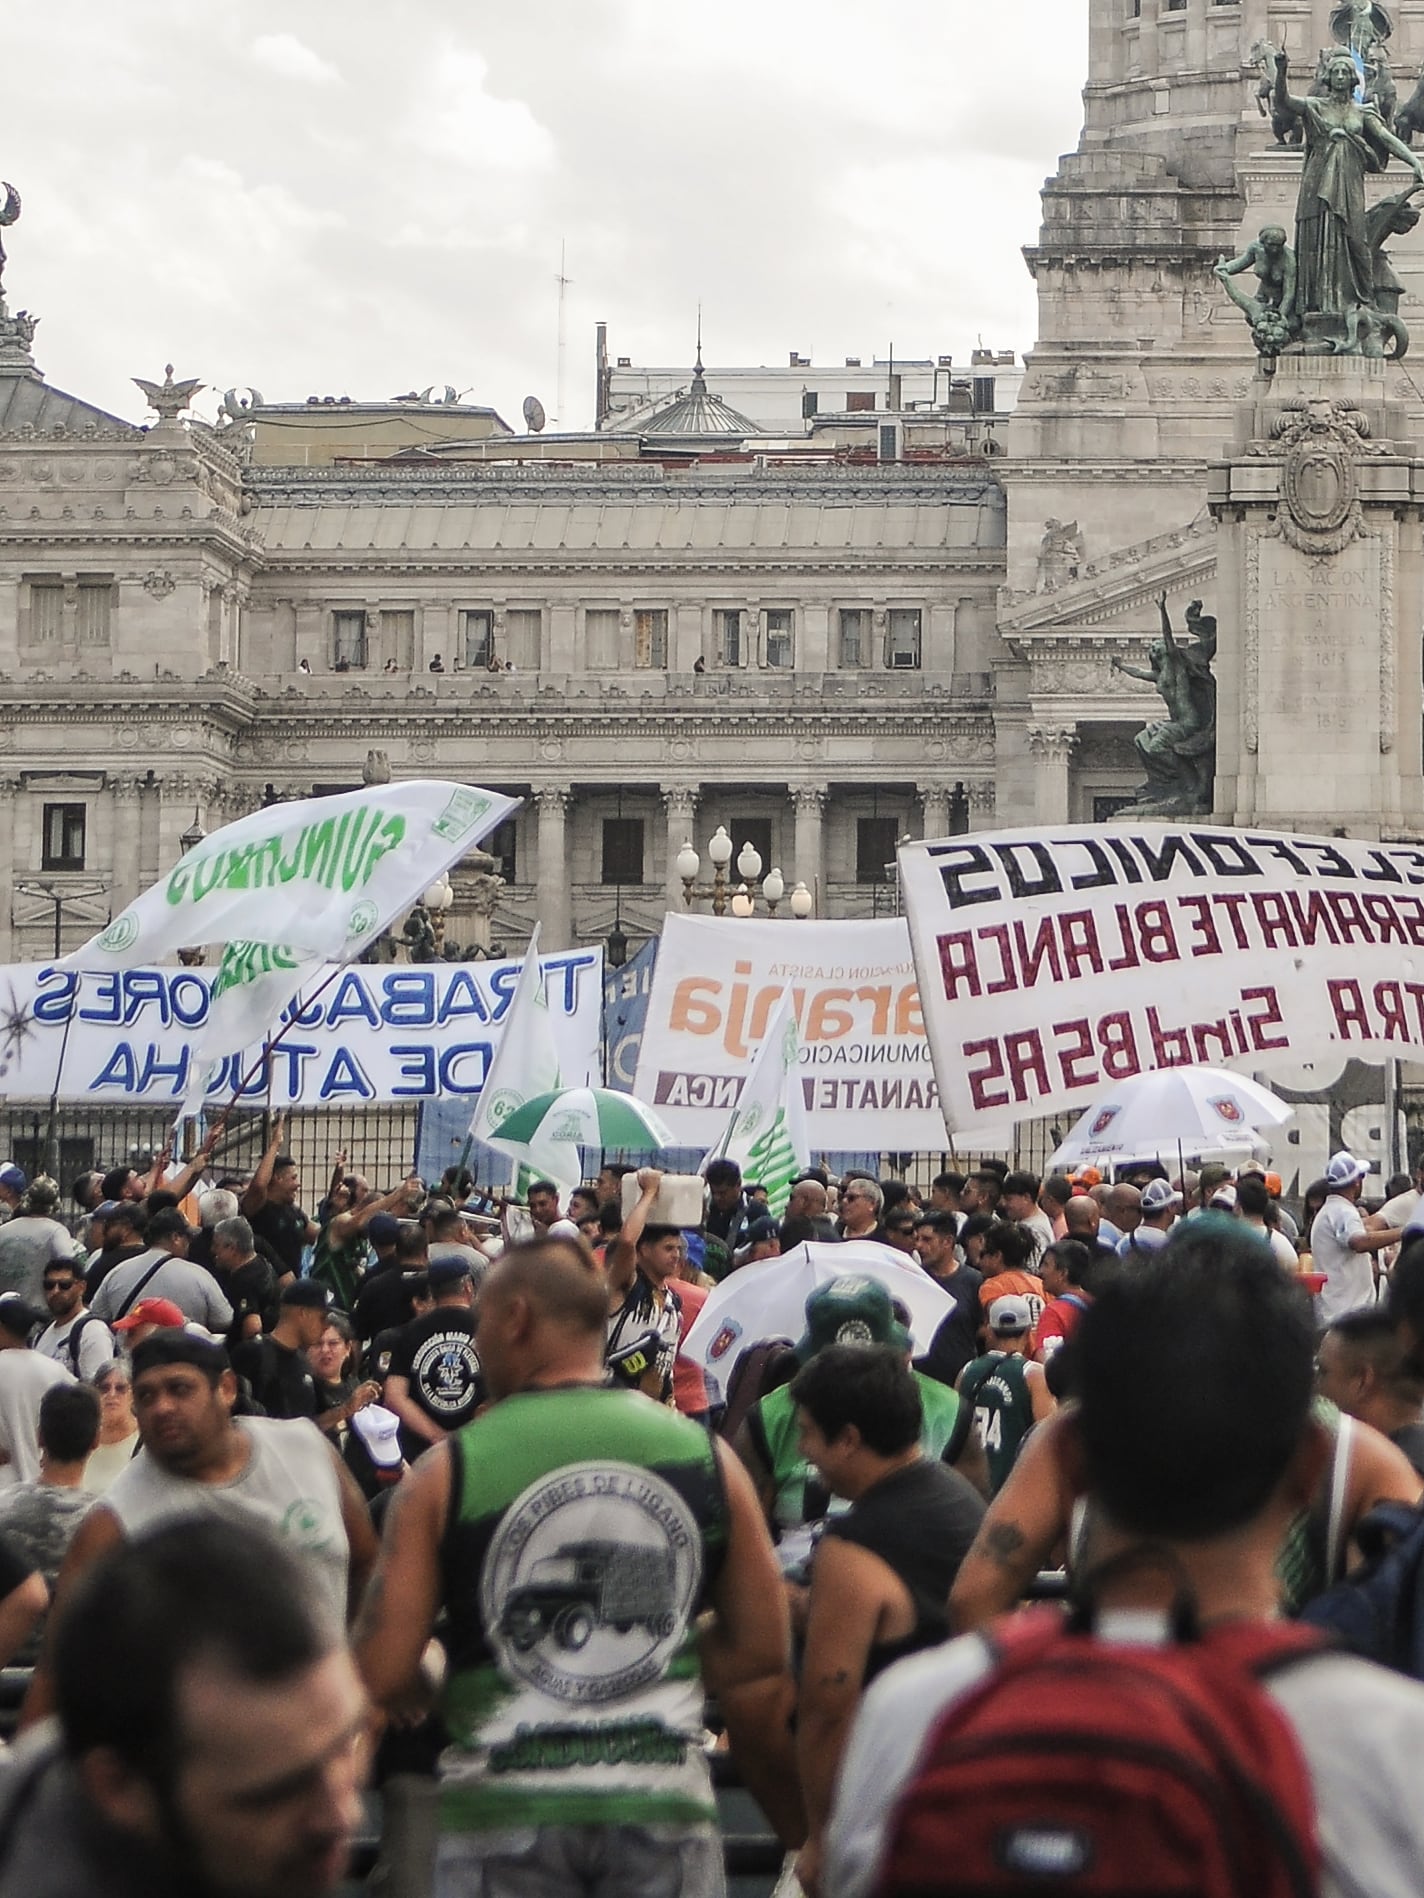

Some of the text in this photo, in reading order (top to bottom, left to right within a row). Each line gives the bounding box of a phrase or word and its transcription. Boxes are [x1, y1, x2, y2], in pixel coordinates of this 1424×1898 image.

[1274, 570, 1366, 586] LA NACON
[1265, 593, 1374, 608] ARGENTINA
